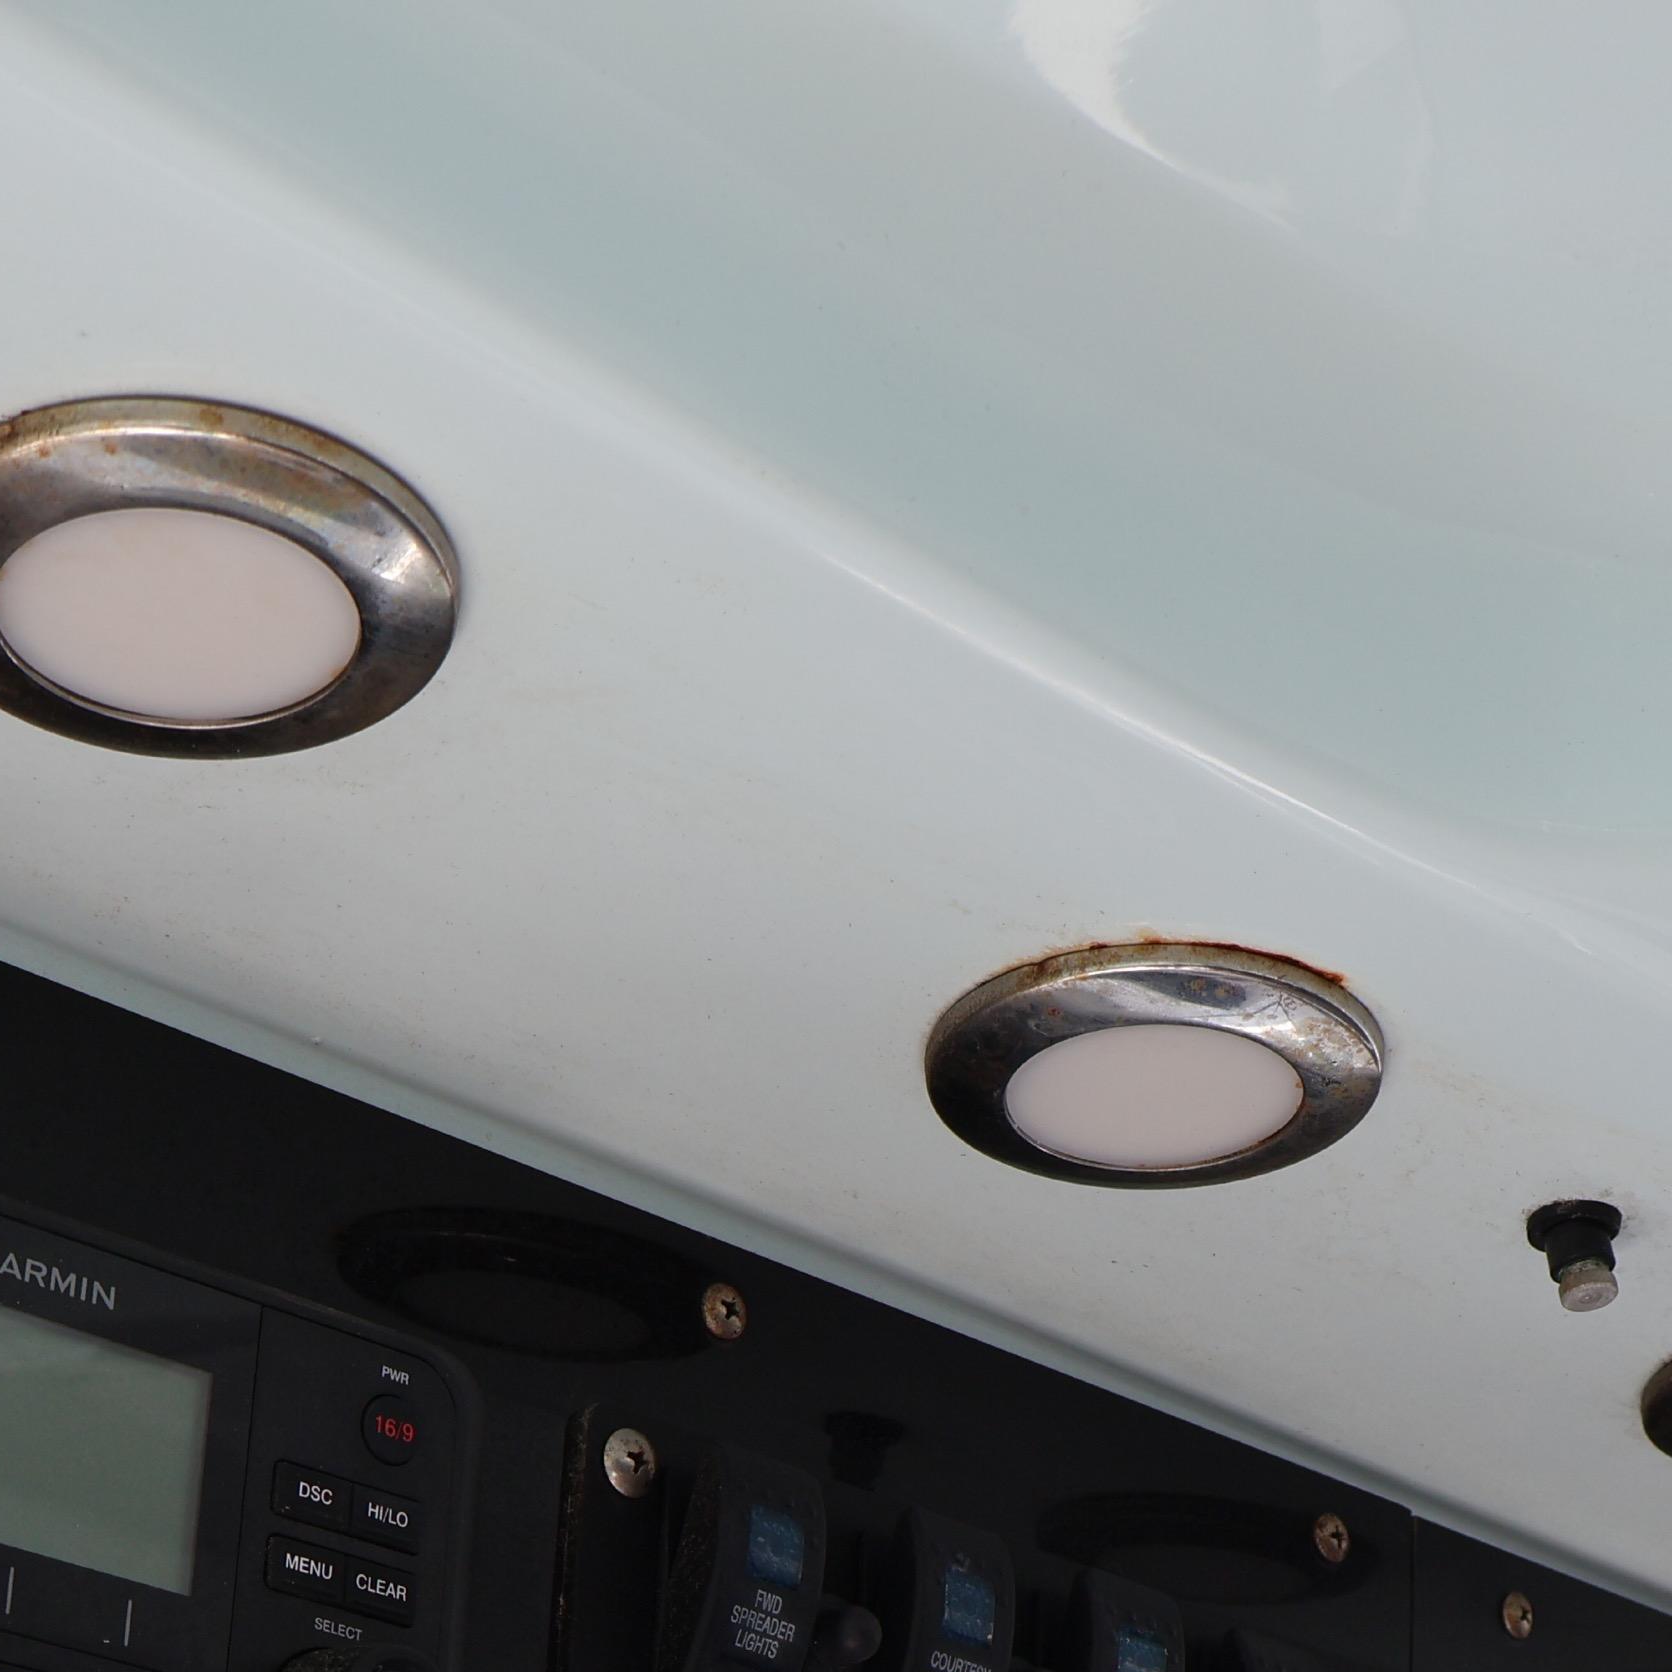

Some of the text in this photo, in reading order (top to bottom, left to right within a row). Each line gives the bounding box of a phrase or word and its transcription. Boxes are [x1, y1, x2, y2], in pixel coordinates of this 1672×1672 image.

[381, 1365, 411, 1386] PWR
[374, 1414, 415, 1443] 16/9
[298, 1480, 333, 1506] DSC
[367, 1502, 409, 1529] HI/LO
[285, 1551, 333, 1580] MENU
[355, 1573, 408, 1603] CLEAR
[755, 1588, 783, 1615] FWD
[314, 1616, 363, 1641] SELECT
[730, 1604, 796, 1643] SPREADER
[733, 1628, 779, 1660] LIGHTS
